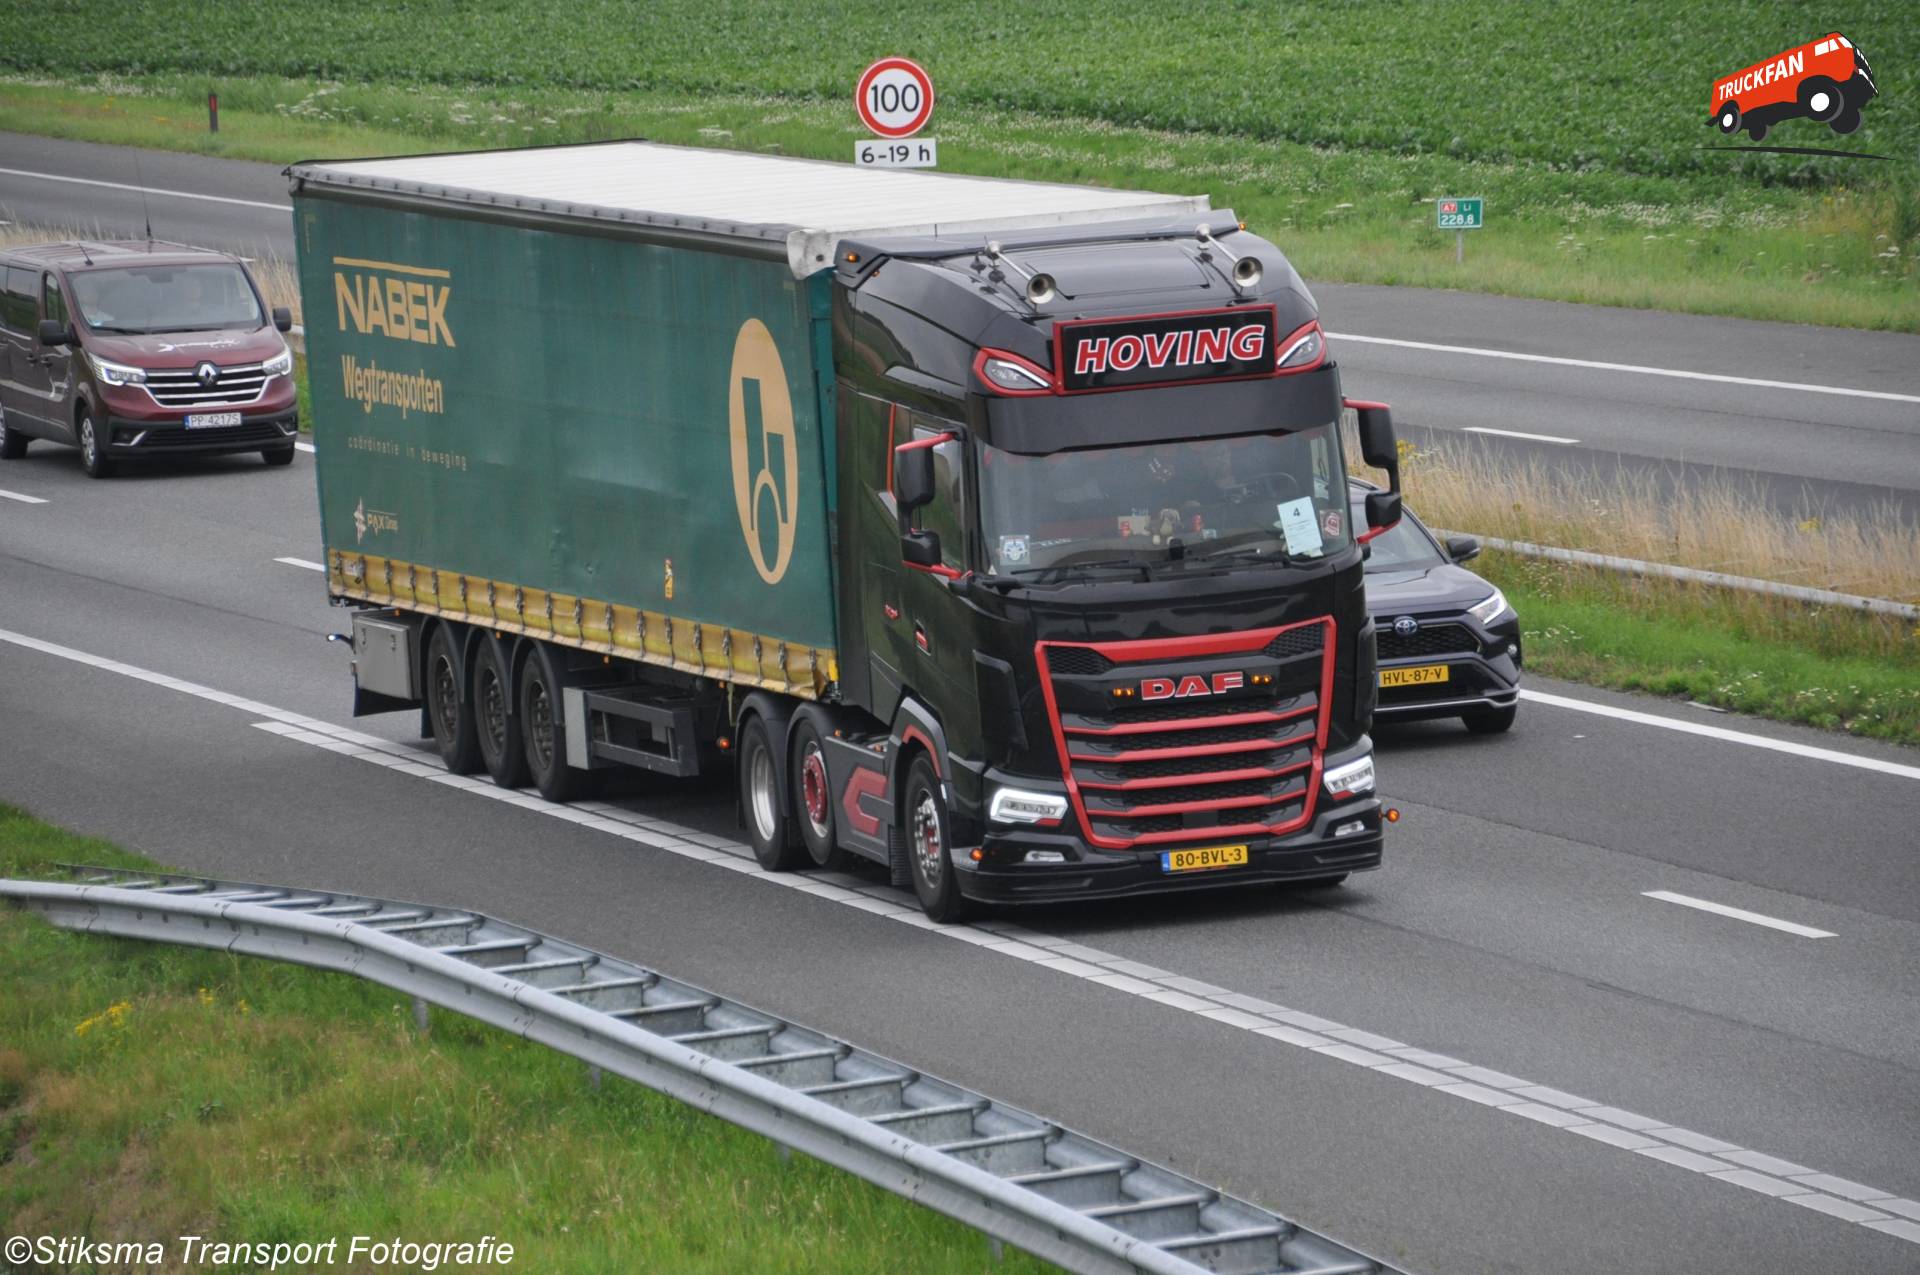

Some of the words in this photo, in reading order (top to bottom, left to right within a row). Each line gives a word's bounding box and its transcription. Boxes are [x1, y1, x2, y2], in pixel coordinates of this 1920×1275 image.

[871, 83, 920, 113] 100
[861, 145, 910, 164] 6-19
[918, 144, 931, 162] h
[1443, 203, 1455, 211] A7
[334, 271, 456, 348] NABEK
[1074, 323, 1266, 375] HOVING
[341, 354, 444, 419] Wegtransporten
[1140, 671, 1244, 701] DAF
[1383, 667, 1442, 685] HVL-87-V
[1175, 848, 1242, 867] 80-BVL-3
